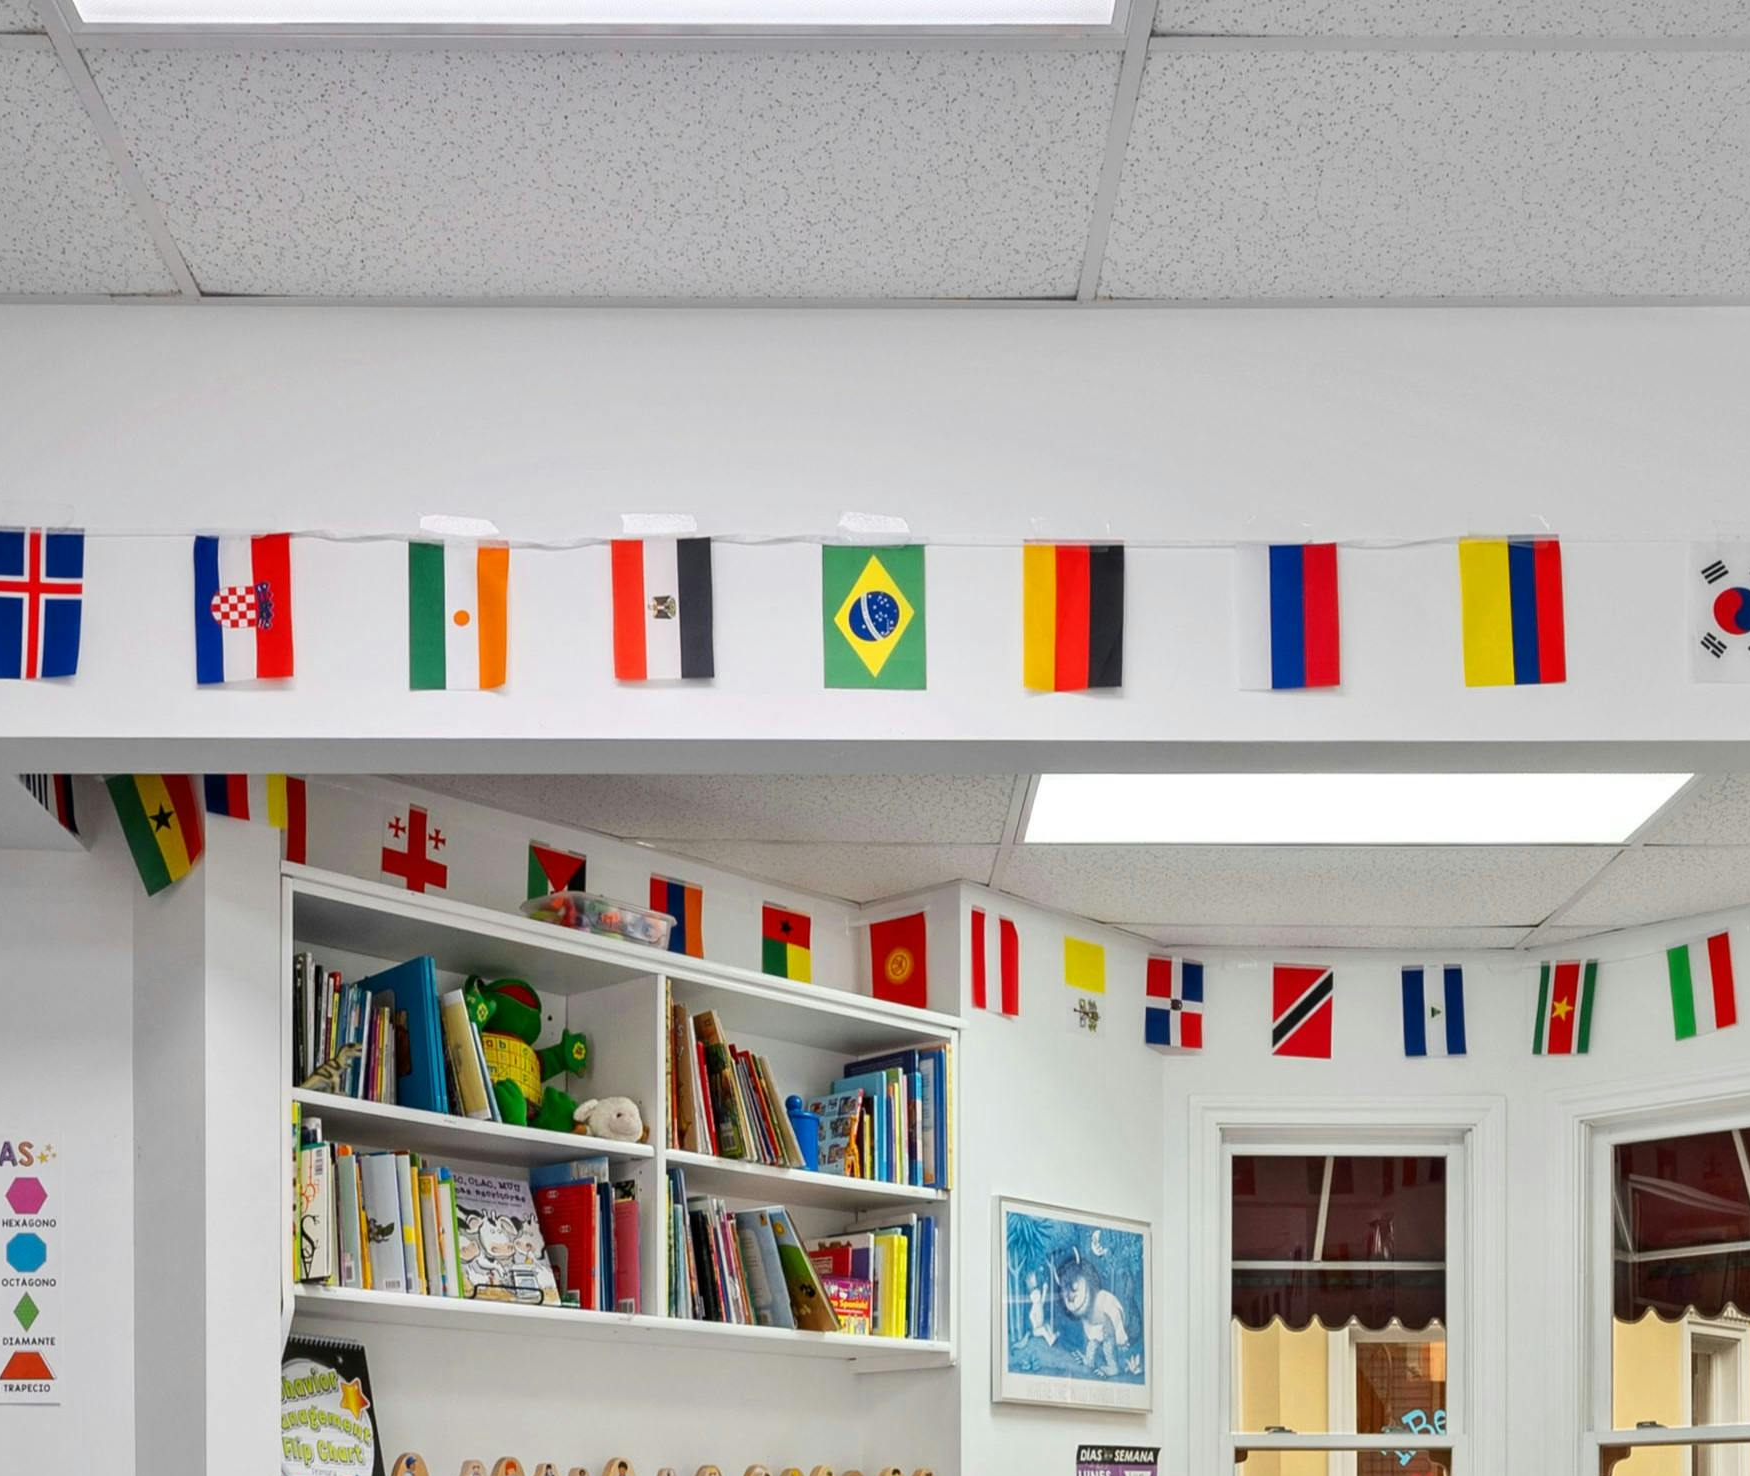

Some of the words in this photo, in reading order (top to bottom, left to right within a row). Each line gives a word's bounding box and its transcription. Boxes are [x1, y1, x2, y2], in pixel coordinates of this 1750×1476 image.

[468, 1175, 497, 1190] CLAC,
[3, 1337, 56, 1346] DIAMANTE
[3, 1383, 51, 1393] TRAPECIO
[282, 1366, 339, 1402] havior
[282, 1404, 372, 1446] anagement
[282, 1436, 315, 1467] Flip
[316, 1439, 366, 1466] Chart
[1079, 1448, 1103, 1462] DÍAS
[1114, 1451, 1155, 1463] SEMANA
